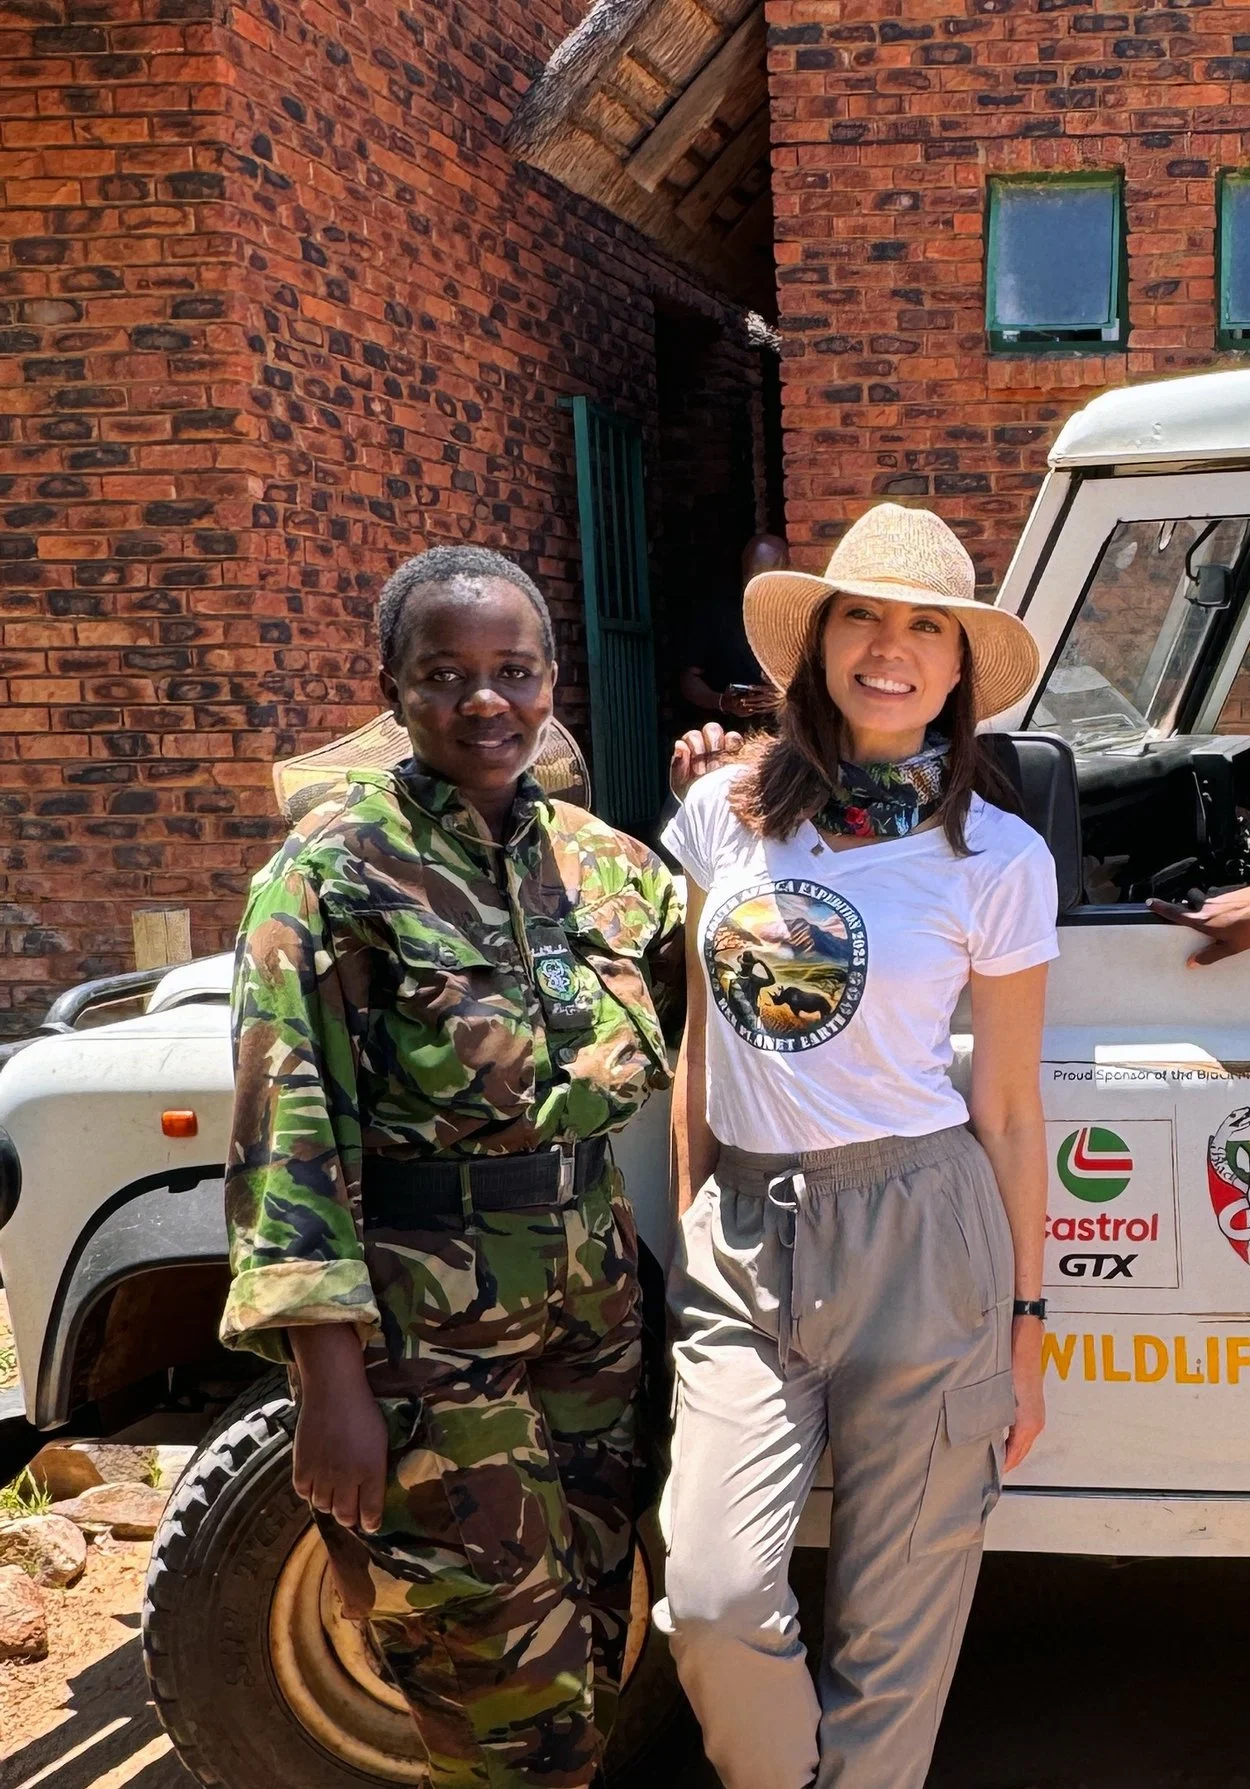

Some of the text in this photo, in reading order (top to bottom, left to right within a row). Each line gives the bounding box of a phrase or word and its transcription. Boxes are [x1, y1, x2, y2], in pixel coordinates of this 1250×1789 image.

[851, 931, 867, 967] 2025
[740, 1024, 796, 1052] PLANET
[800, 1013, 847, 1049] EARTH
[1053, 1069, 1093, 1082] Proud
[1095, 1069, 1149, 1083] Sponsor
[1155, 1069, 1168, 1081] of
[1045, 1213, 1159, 1242] astrol
[1058, 1253, 1139, 1280] GTX
